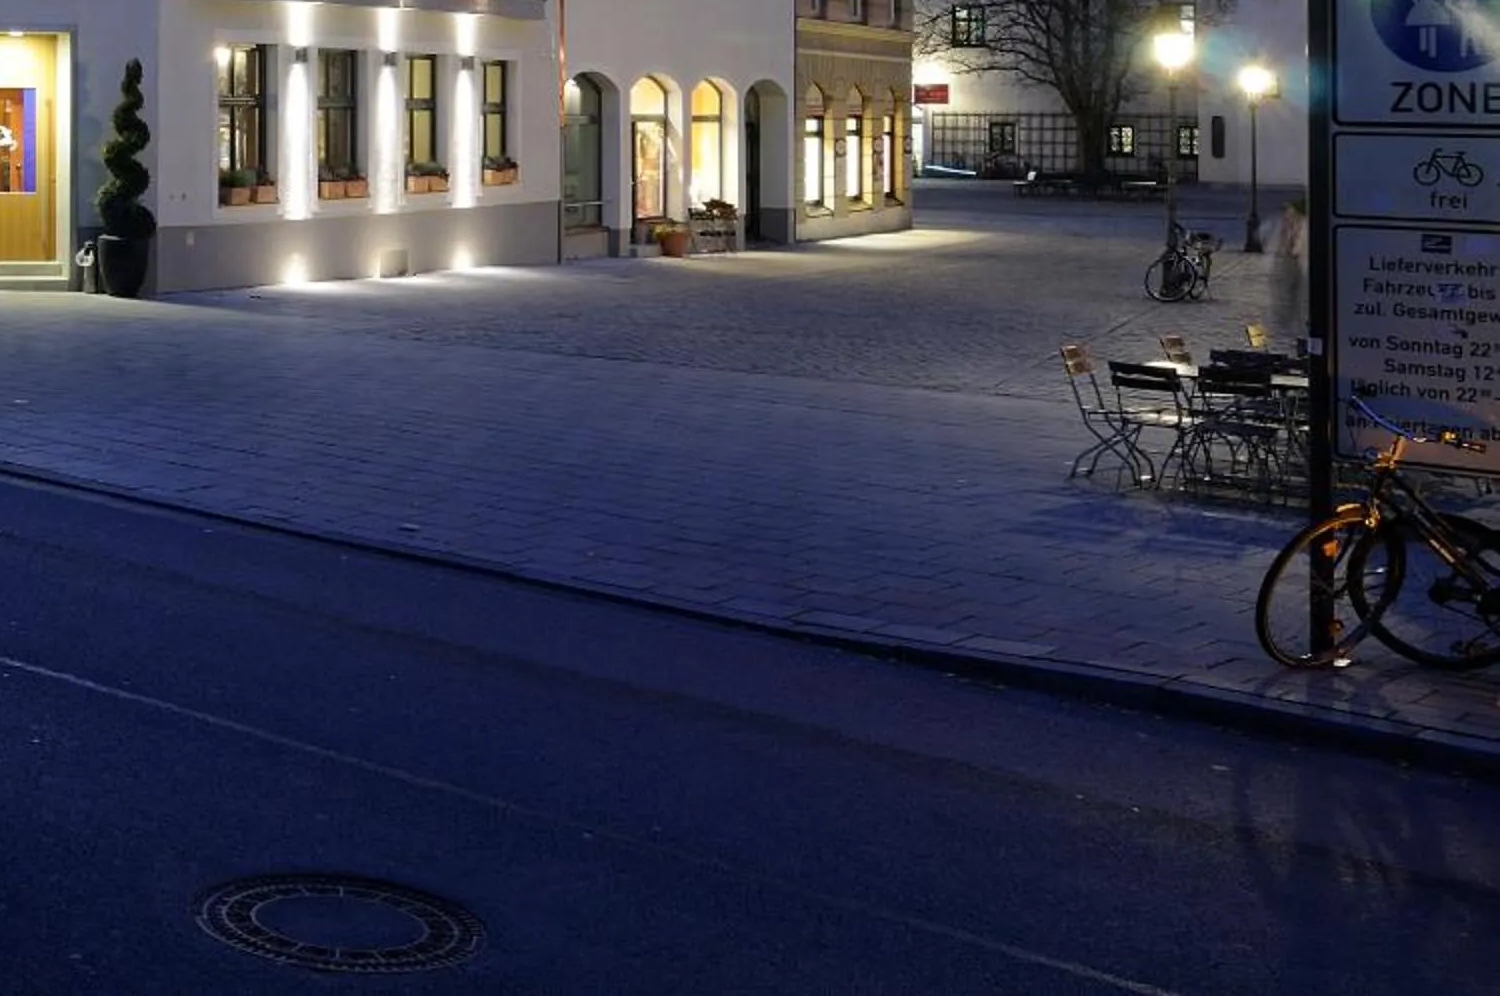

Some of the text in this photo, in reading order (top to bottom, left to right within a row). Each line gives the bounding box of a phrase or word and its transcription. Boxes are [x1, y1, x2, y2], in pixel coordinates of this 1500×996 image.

[1390, 81, 1500, 114] ZONE
[1430, 190, 1467, 210] frei
[1369, 256, 1500, 278] Lieferverkehr
[1468, 284, 1496, 301] bis
[1349, 336, 1380, 349] von
[1386, 336, 1463, 358] Sonntag
[1384, 359, 1466, 382] Samstag
[1417, 386, 1450, 401] von
